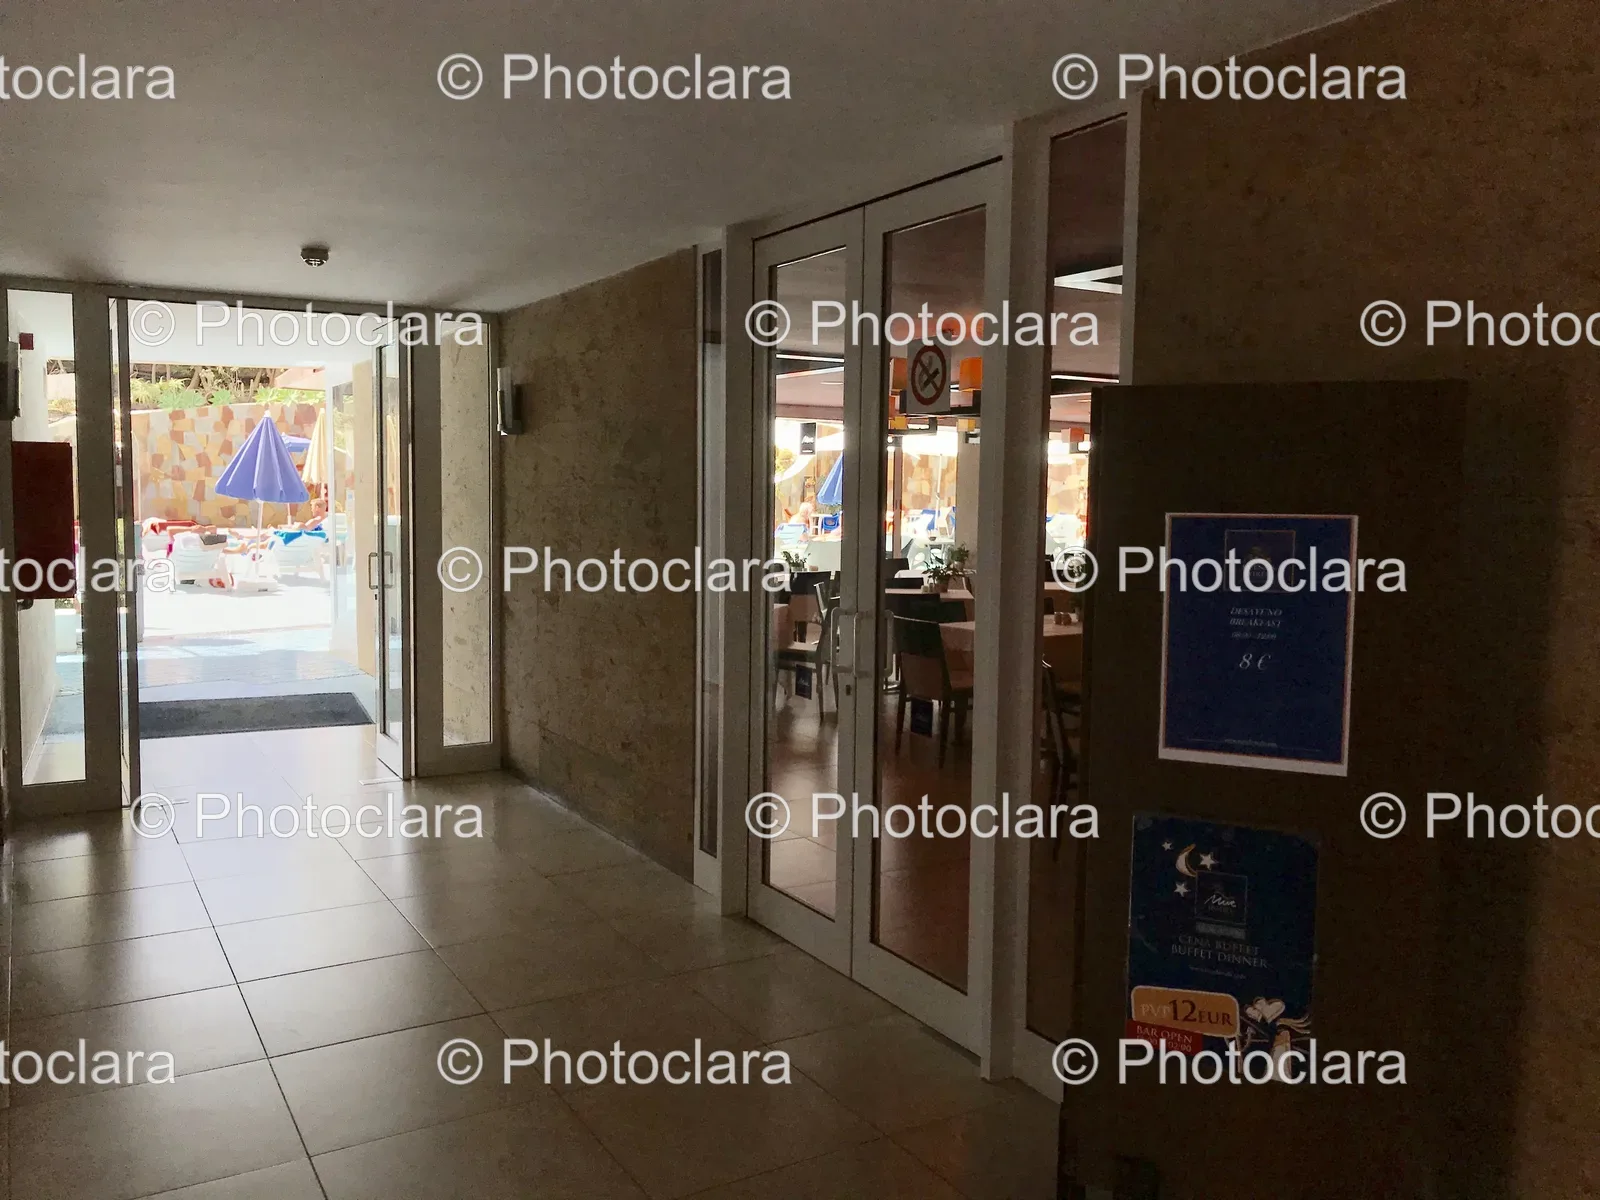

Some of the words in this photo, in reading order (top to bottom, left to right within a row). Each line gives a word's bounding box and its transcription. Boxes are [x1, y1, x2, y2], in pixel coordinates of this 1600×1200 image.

[1239, 653, 1253, 670] 8
[1171, 943, 1212, 960] BUFFET
[1217, 952, 1268, 968] DINNER
[1140, 1003, 1171, 1018] PVP
[1136, 1025, 1158, 1038] BAR
[1160, 1029, 1193, 1044] OPEN
